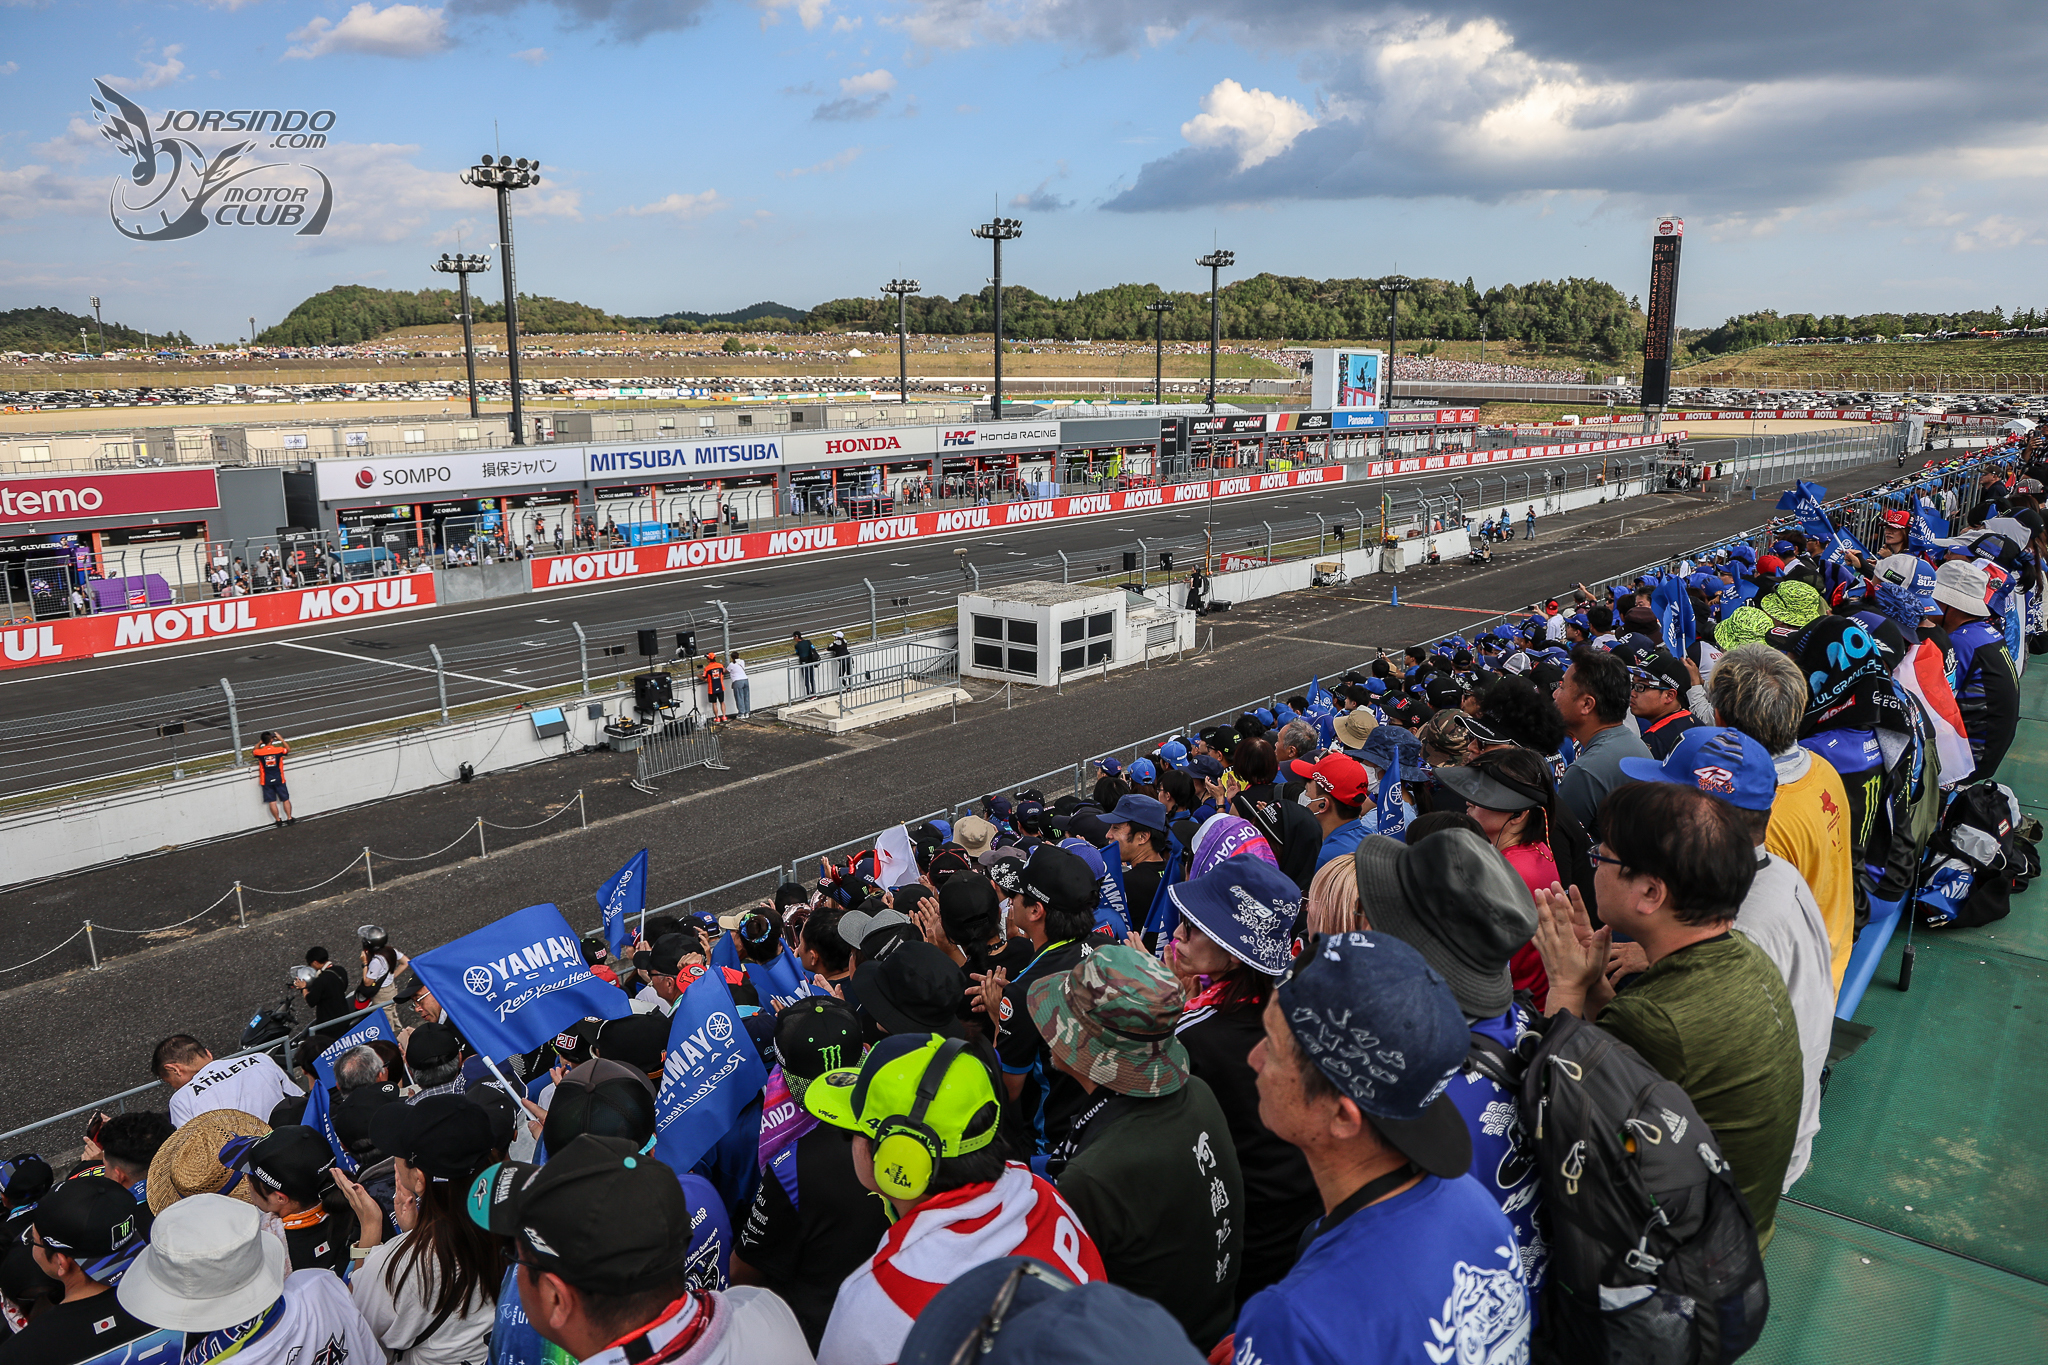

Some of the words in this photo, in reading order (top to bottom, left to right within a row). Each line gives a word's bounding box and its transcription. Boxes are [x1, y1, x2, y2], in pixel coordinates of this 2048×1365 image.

[1348, 414, 1374, 425] Panasonic
[1661, 413, 1679, 421] OTUL
[1685, 412, 1712, 420] MOTUL
[1718, 411, 1744, 419] MOTUL
[1782, 410, 1808, 419] MOTUL
[1813, 410, 1838, 418] MOTUL
[1843, 411, 1867, 419] MOTUL
[1194, 422, 1223, 430] ADVAN
[1233, 420, 1260, 428] ADVAN
[943, 430, 976, 446] HRC
[981, 431, 1018, 441] Honda
[1019, 429, 1057, 439] RACING
[826, 436, 901, 454] HONDA
[1512, 448, 1527, 459] MOTUL
[1530, 447, 1544, 457] MOTUL
[1547, 445, 1561, 455] MOTUL
[590, 449, 686, 472] MITSUBA
[695, 443, 779, 465] MITSUBA
[1425, 456, 1444, 469] MOTUL
[1449, 454, 1467, 466] MOTUL
[1471, 452, 1488, 464] MOTUL
[1492, 450, 1508, 461] MOTUL
[482, 460, 557, 478] 損保ジャパン
[1371, 462, 1393, 476] MOTUL
[1399, 459, 1420, 472] MOTUL
[383, 466, 451, 485] SOMPO
[1260, 473, 1289, 489] MOTUL
[1297, 469, 1323, 484] MOTUL
[1174, 483, 1209, 502] MOTUL
[1219, 478, 1251, 496] MOTUL
[0, 487, 103, 516] temo
[1068, 495, 1112, 515] MOTUL
[1124, 489, 1162, 508] MOTUL
[936, 508, 990, 532] MOTUL
[1006, 501, 1054, 523] MOTUL
[858, 517, 919, 543] MOTUL
[768, 526, 837, 555] MOTUL
[666, 538, 745, 568] MOTUL
[548, 551, 639, 584] MOTUL
[1225, 556, 1271, 571] MOT
[1917, 579, 1936, 588] SUZ
[299, 578, 417, 621] MOTUL
[115, 600, 257, 647] MOTUL
[3, 626, 63, 661] UL
[1833, 664, 1867, 695] GRAND
[1694, 765, 1733, 785] 42
[1237, 824, 1256, 841] OF
[485, 959, 578, 1002] RACIN
[495, 987, 534, 1023] Revs
[532, 976, 568, 1000] Your
[1001, 1003, 1012, 1016] ulf
[556, 1033, 578, 1050] 20
[192, 1055, 260, 1097] ATHLETA
[759, 1101, 796, 1135] AND
[260, 1171, 282, 1190] YAMAHA
[699, 1227, 718, 1252] Quartararo
[511, 1305, 519, 1326] SPAIN
